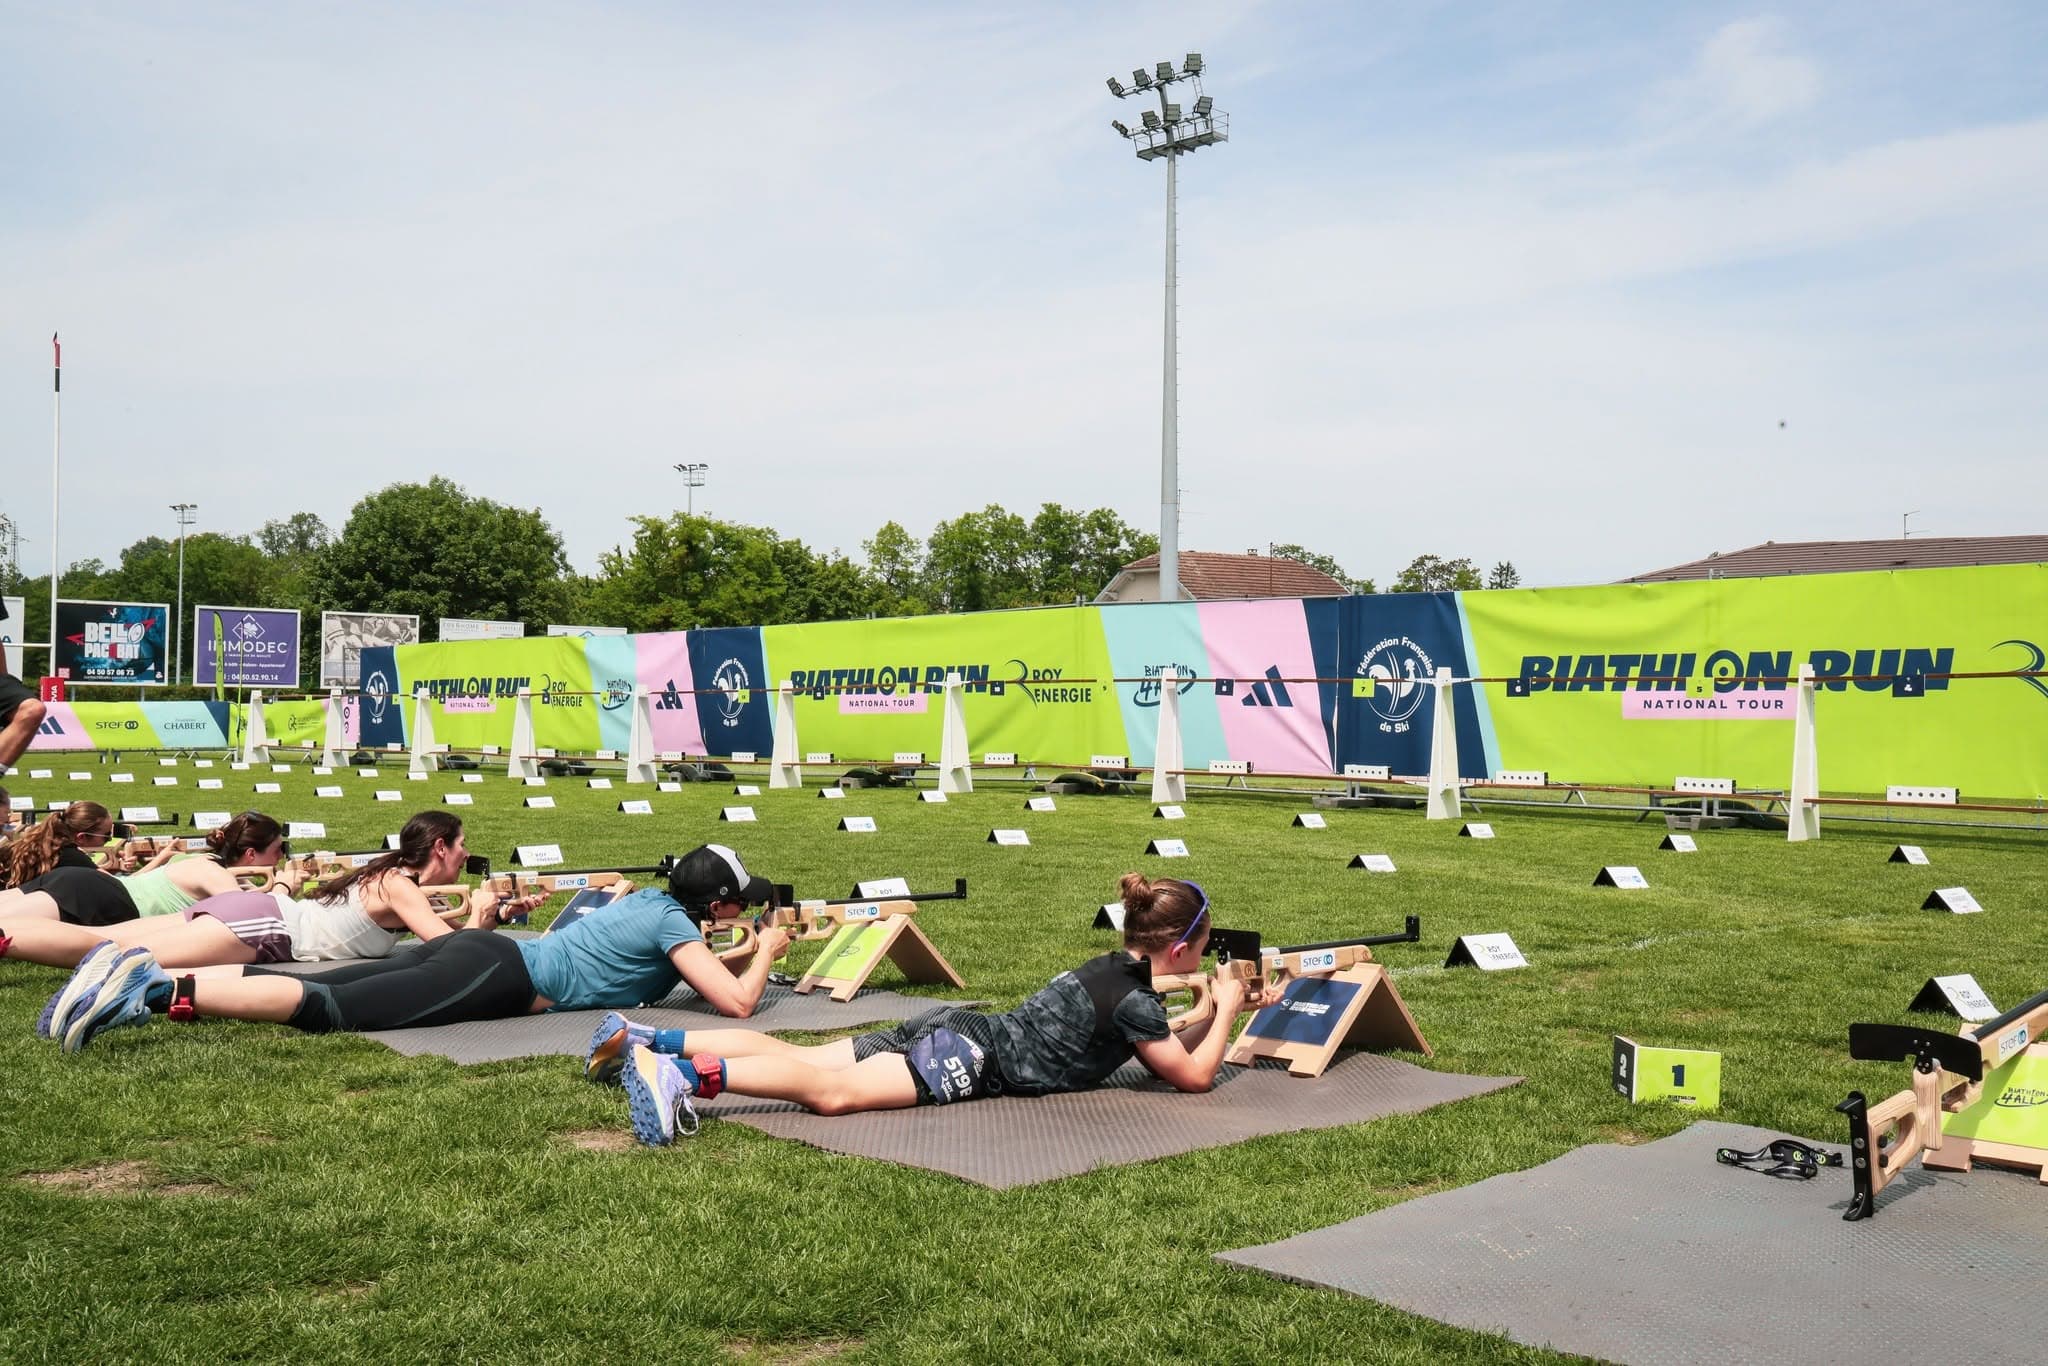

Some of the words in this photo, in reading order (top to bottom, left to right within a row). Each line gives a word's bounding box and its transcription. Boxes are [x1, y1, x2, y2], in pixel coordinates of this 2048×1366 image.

[1357, 638, 1399, 676] Fédération
[1401, 636, 1435, 677] Française
[1032, 669, 1062, 681] ROY
[1144, 663, 1188, 677] BIATON
[1807, 648, 1955, 693] RUN
[552, 682, 567, 693] ROY
[791, 666, 919, 696] BIATHLON
[1034, 687, 1092, 703] ENERGIE
[893, 699, 915, 707] TOUR
[1643, 700, 1728, 709] NATIONAL
[1737, 699, 1785, 709] TOUR
[164, 722, 207, 730] CHABERT
[1379, 721, 1392, 733] de
[1394, 720, 1410, 733] Ski
[1619, 1053, 1628, 1078] 2
[1671, 1064, 1685, 1087] 1
